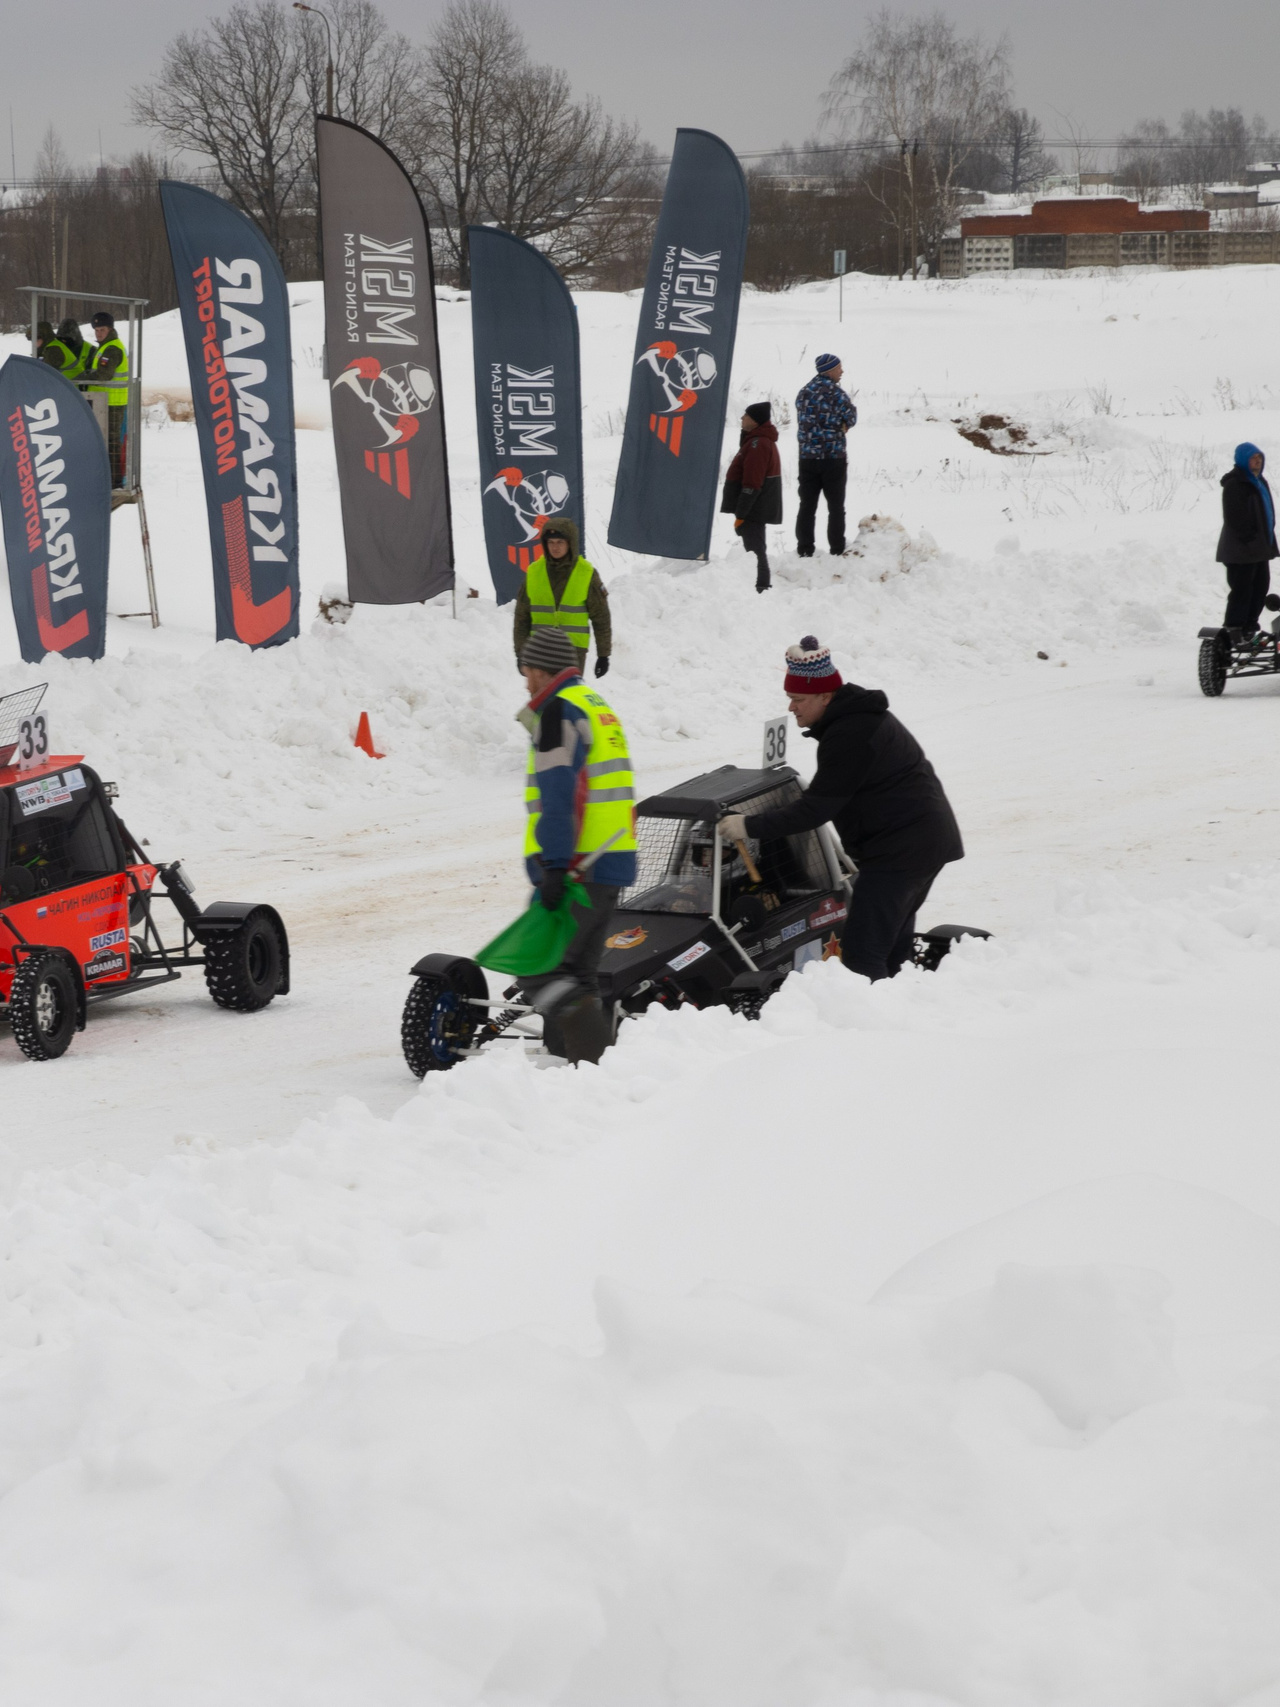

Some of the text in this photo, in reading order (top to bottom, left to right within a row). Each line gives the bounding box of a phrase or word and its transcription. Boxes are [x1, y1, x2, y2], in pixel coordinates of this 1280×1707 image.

[21, 715, 48, 760] 33
[766, 724, 787, 761] 38
[21, 795, 46, 810] NWB
[49, 896, 80, 915] ЧАГИН
[91, 928, 126, 951] RUSTA
[783, 920, 806, 940] RUSTA
[86, 957, 124, 976] KRAMAR
